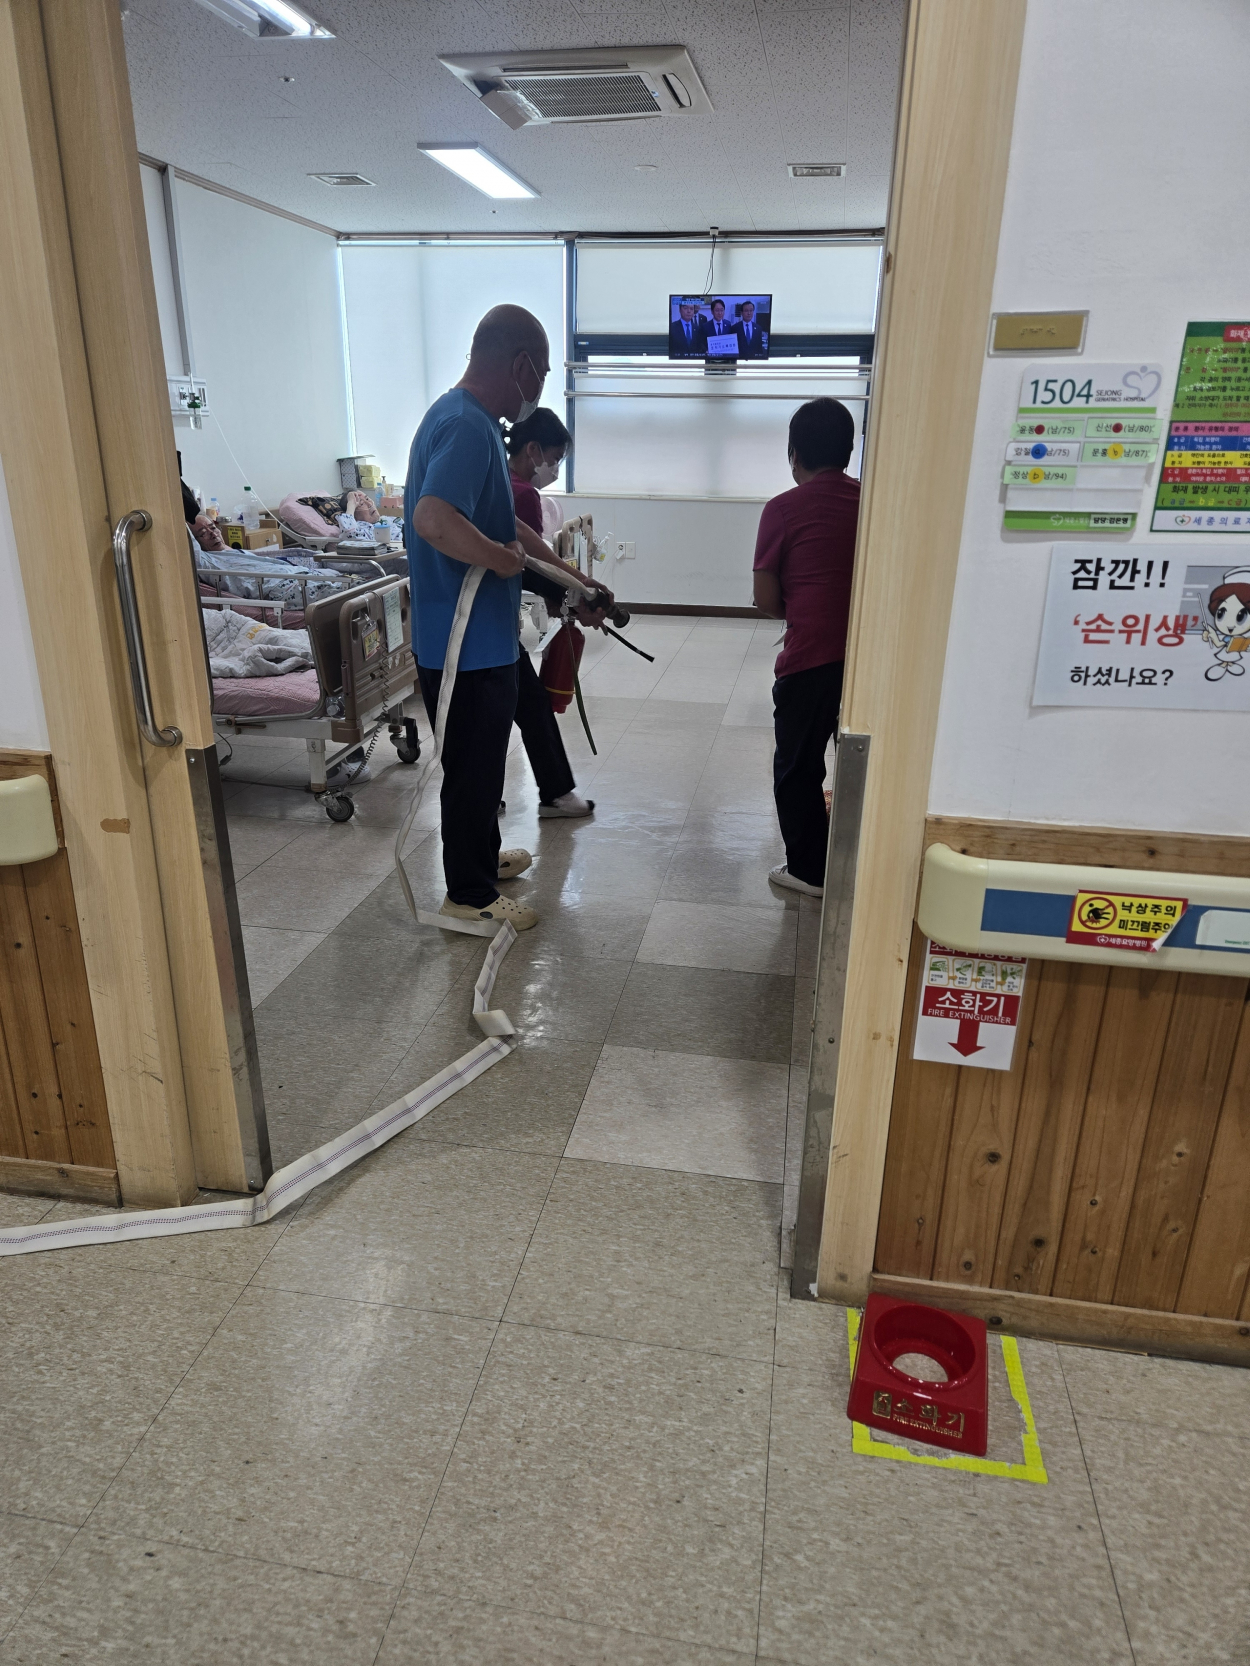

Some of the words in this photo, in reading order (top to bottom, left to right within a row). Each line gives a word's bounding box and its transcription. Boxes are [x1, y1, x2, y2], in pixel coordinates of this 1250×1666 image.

[1030, 378, 1093, 405] 1504
[1047, 425, 1075, 435] (남/75)
[1123, 424, 1152, 434] (남/80)
[1171, 485, 1188, 495] 화재
[1192, 485, 1208, 495] 발생
[1211, 485, 1220, 495] 시
[1223, 485, 1240, 495] 대피
[1070, 556, 1170, 591] 잠깐!!
[1072, 613, 1199, 648] ‘손위생’
[1069, 665, 1174, 688] 하셨나요?
[1120, 901, 1178, 918] 낙상주의
[935, 990, 1005, 1017] 소화기
[927, 1008, 945, 1017] FIRE
[949, 1010, 1012, 1025] EXTINGUISHER
[892, 1413, 909, 1425] FIRE
[909, 1420, 963, 1439] EXTINGUISHER
[893, 1398, 965, 1433] 소화기
